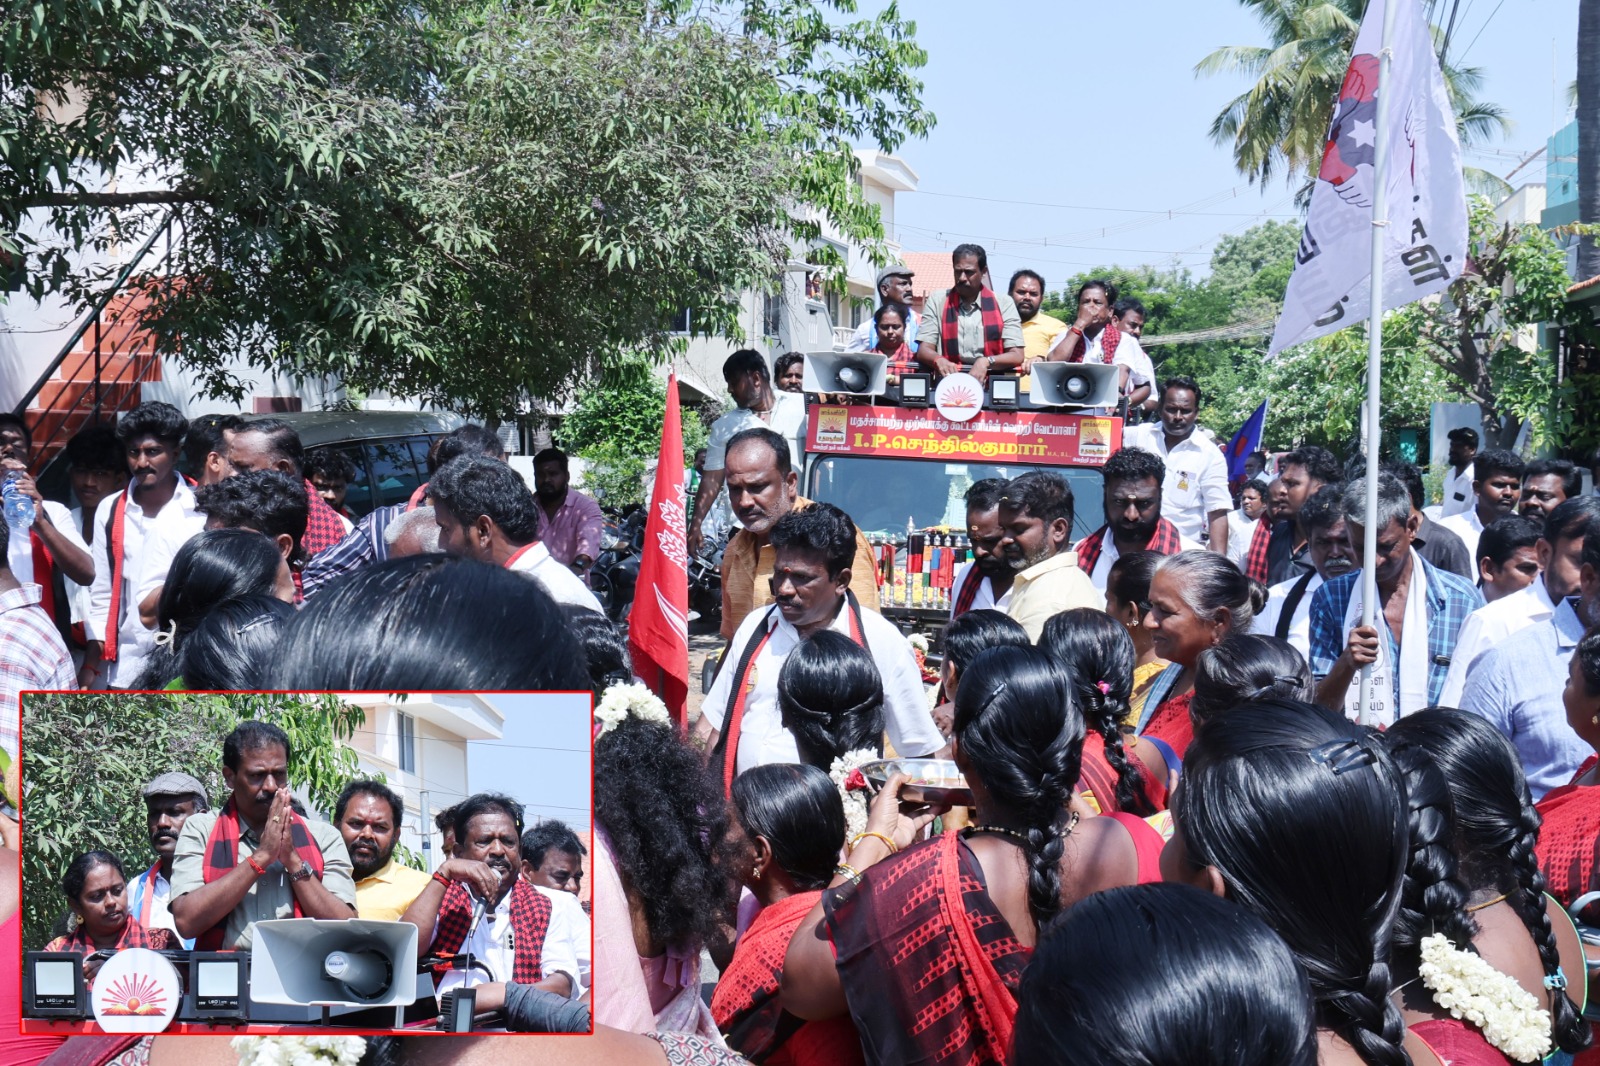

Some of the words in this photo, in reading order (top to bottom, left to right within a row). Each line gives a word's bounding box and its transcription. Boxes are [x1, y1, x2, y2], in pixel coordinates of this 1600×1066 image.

[850, 413, 904, 430] மதச்சார்பற்ற
[904, 415, 949, 432] முற்போக்கு
[1002, 420, 1032, 436] வெற்றி
[1033, 422, 1078, 436] வேட்பாளர்
